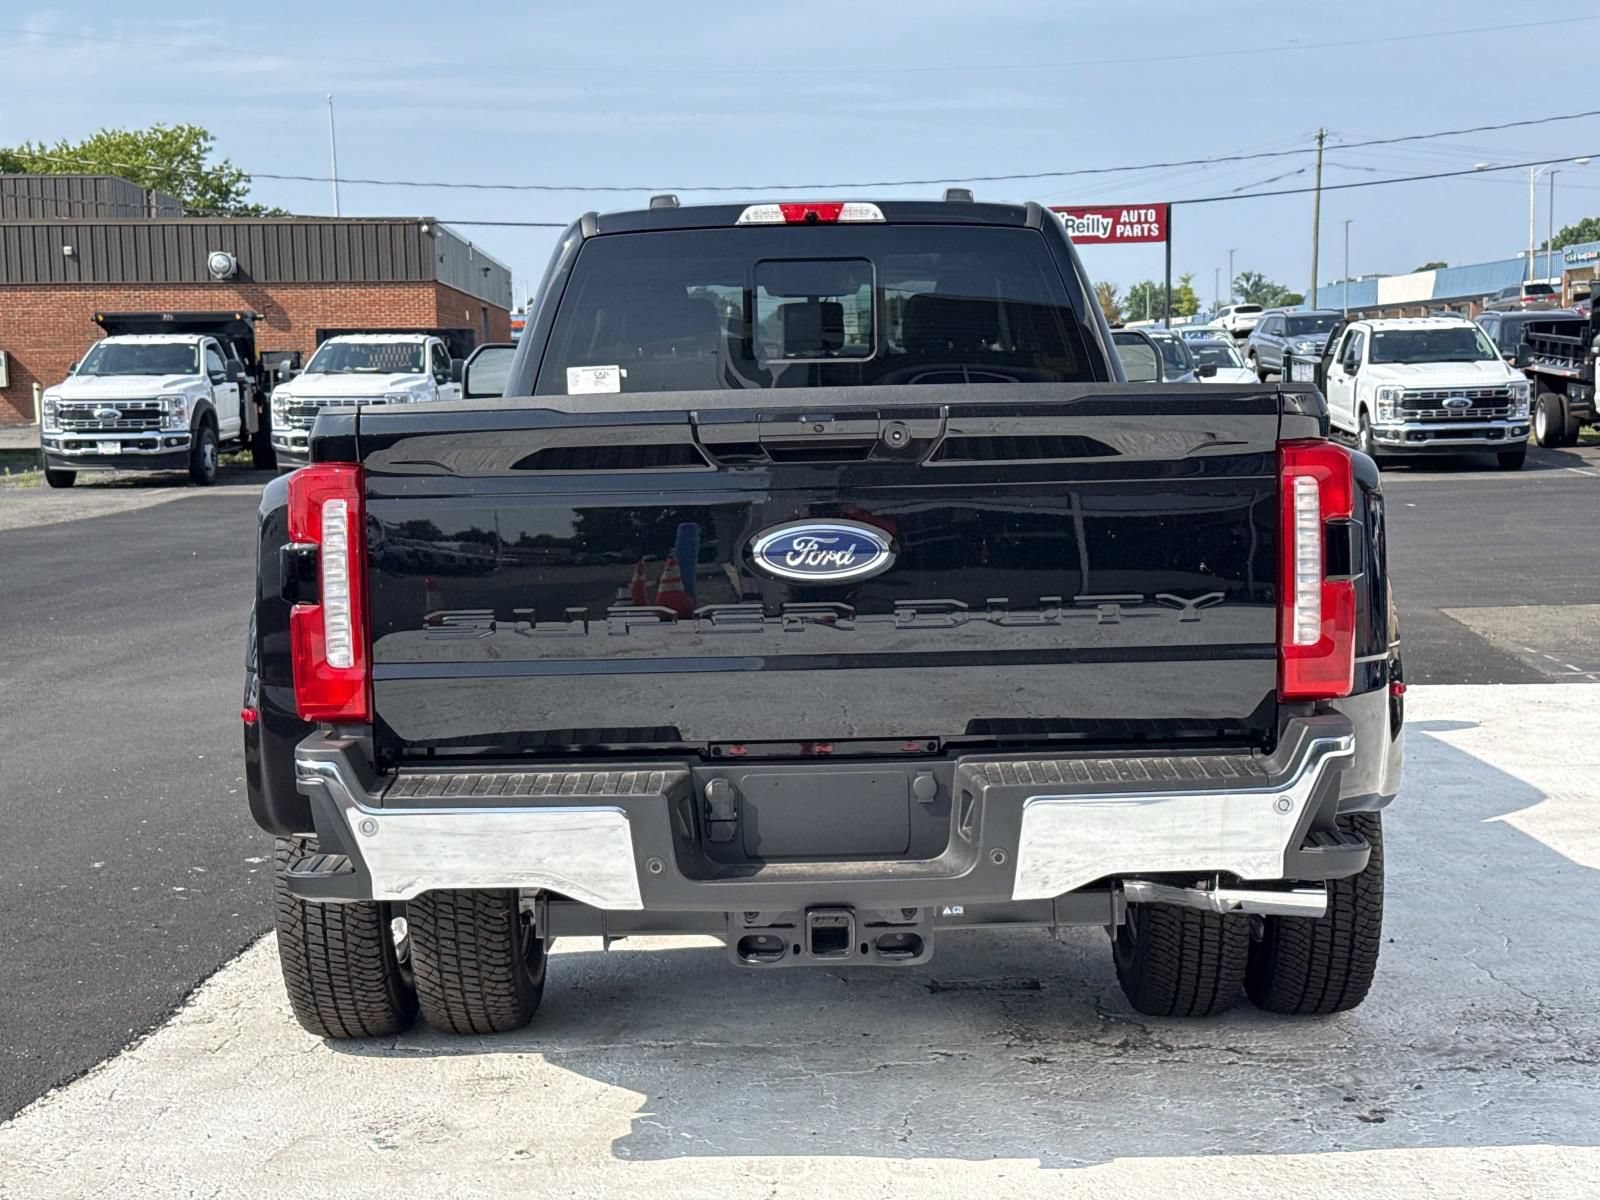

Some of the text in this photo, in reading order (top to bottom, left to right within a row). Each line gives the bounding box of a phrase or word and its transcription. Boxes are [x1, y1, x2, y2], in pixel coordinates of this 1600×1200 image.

[1060, 213, 1111, 236] 'Reilly
[1120, 209, 1156, 223] AUTO
[1116, 224, 1159, 237] PARTS
[786, 536, 857, 567] Ford
[423, 592, 1225, 641] SUPER DUTY
